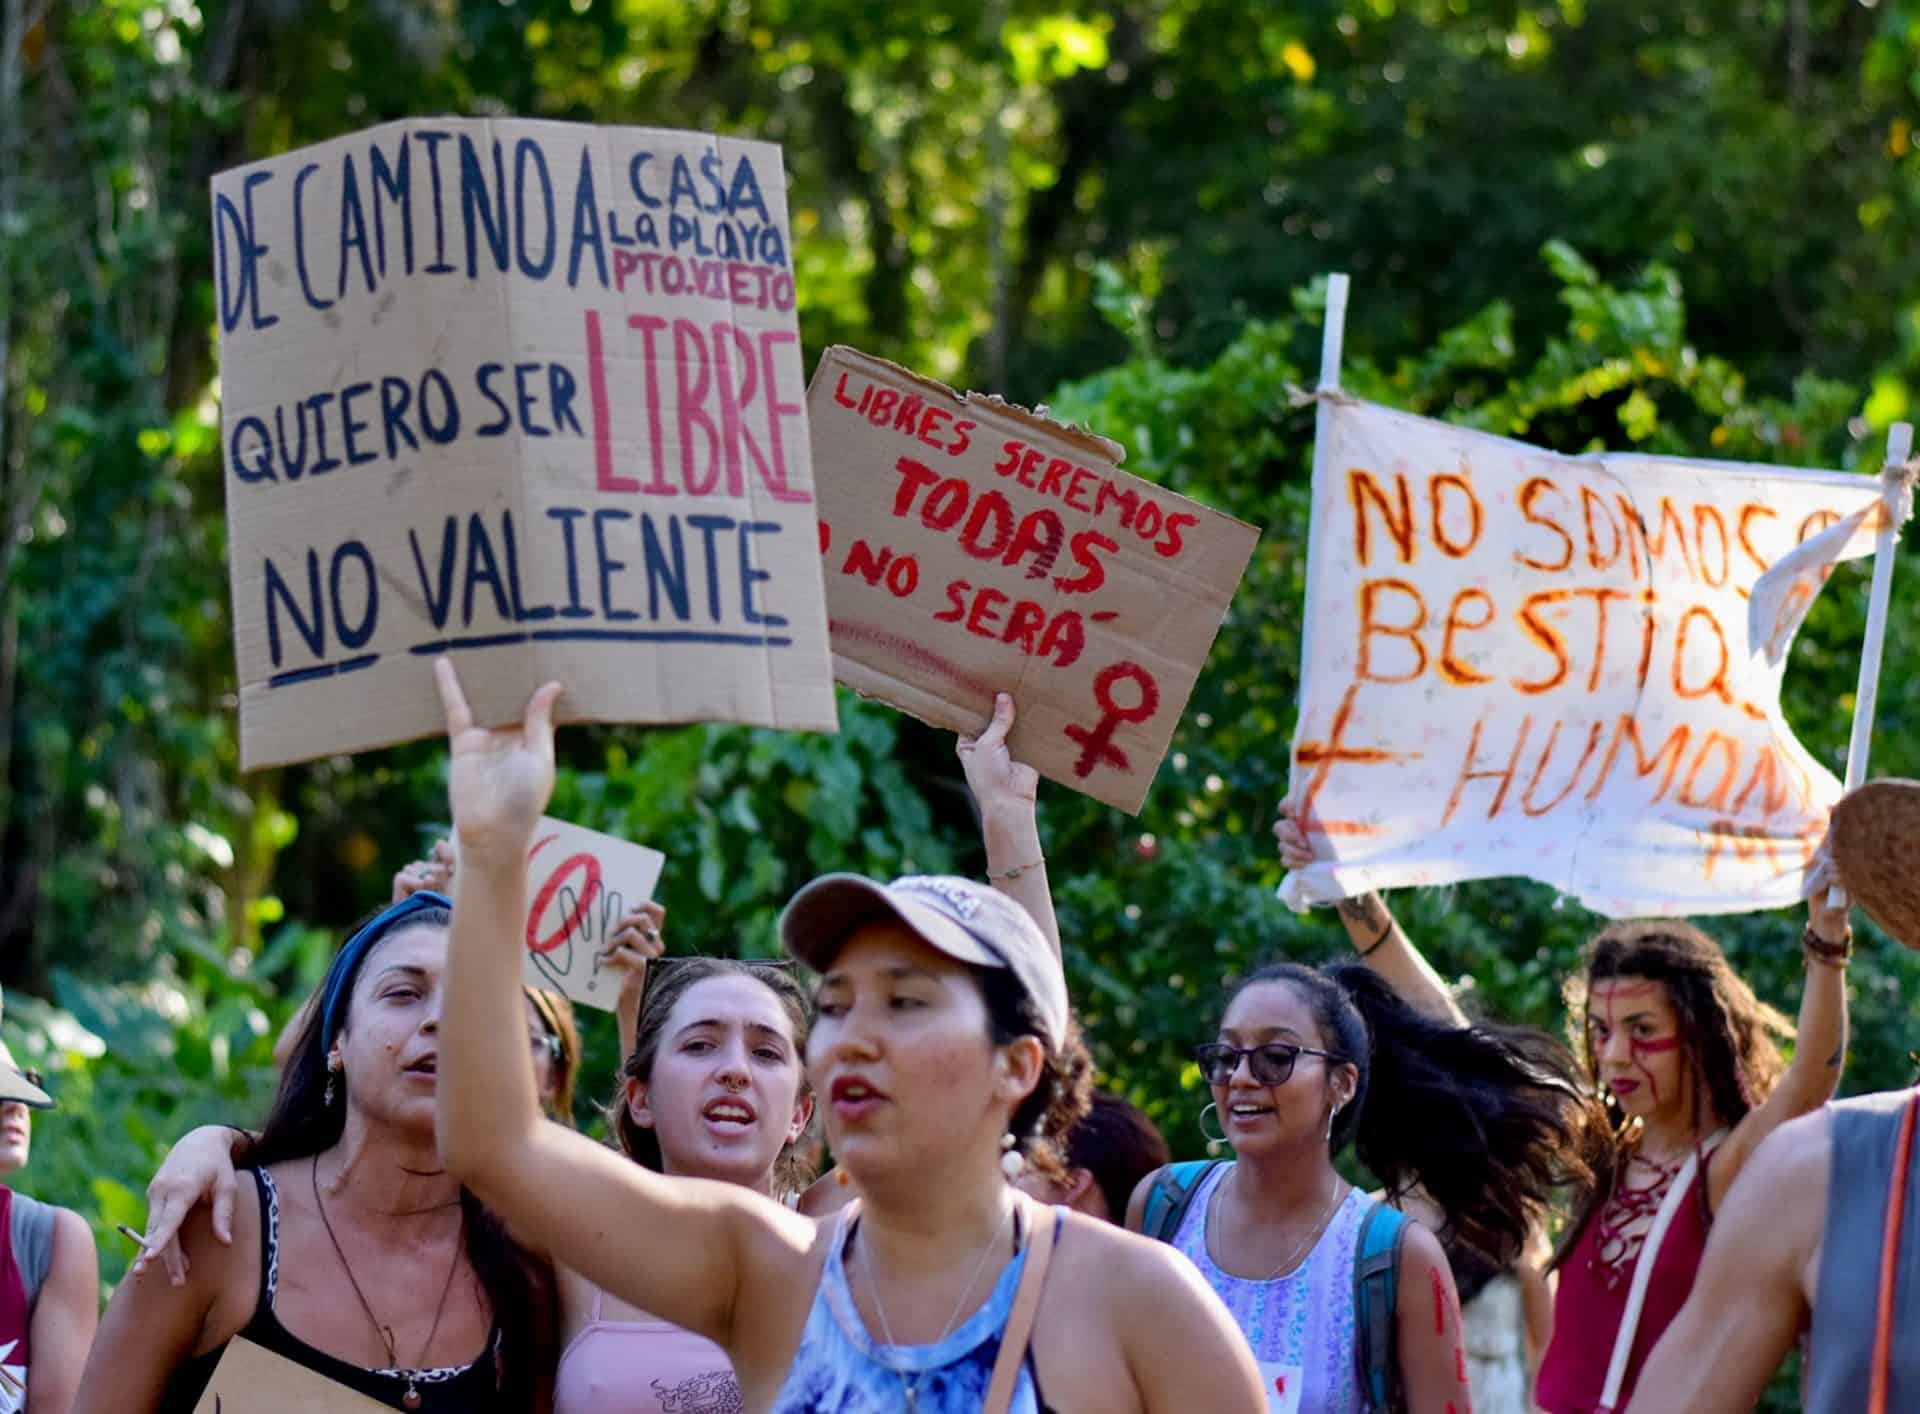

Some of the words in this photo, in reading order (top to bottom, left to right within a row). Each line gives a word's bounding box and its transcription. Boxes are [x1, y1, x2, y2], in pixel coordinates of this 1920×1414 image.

[217, 171, 280, 332] DE
[294, 130, 557, 310] CAMINO
[567, 144, 610, 290] A
[629, 145, 771, 225] CASA
[231, 368, 461, 484] QUIERO
[476, 363, 584, 438] SER
[584, 309, 813, 503] LIBRE
[834, 372, 977, 457] LIBRES
[994, 440, 1201, 558] SEREMOS
[264, 539, 380, 668] NO
[409, 508, 789, 630] VALIENTE
[842, 539, 919, 597] NO
[891, 456, 1121, 594] TODAS
[1346, 468, 1486, 568] NO
[1512, 475, 1778, 601] SOMOS
